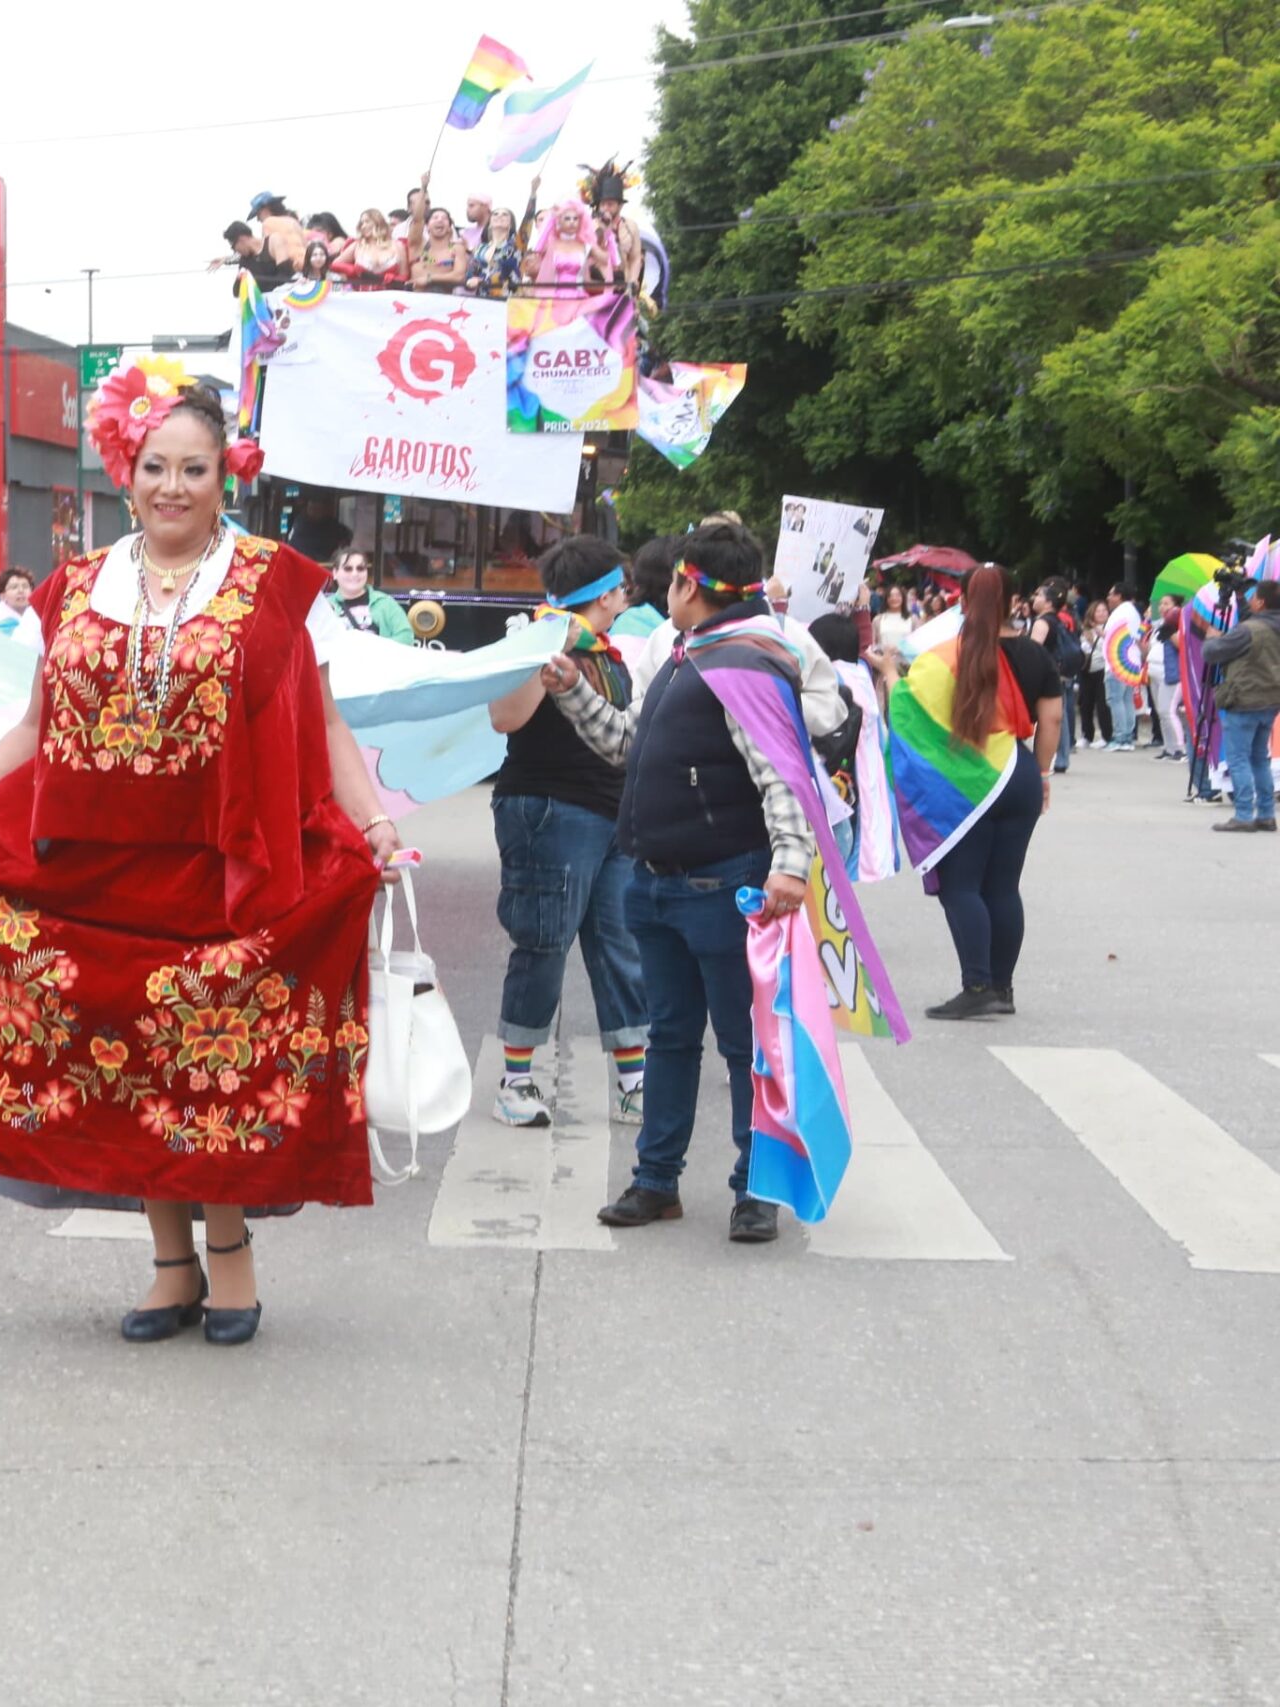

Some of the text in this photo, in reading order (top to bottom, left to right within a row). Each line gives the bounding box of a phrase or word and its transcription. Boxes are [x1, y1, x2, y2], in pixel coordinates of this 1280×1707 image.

[400, 329, 455, 392] G
[532, 367, 610, 379] CHUMACERO
[533, 349, 609, 369] GABY
[363, 436, 472, 478] GAROTOS
